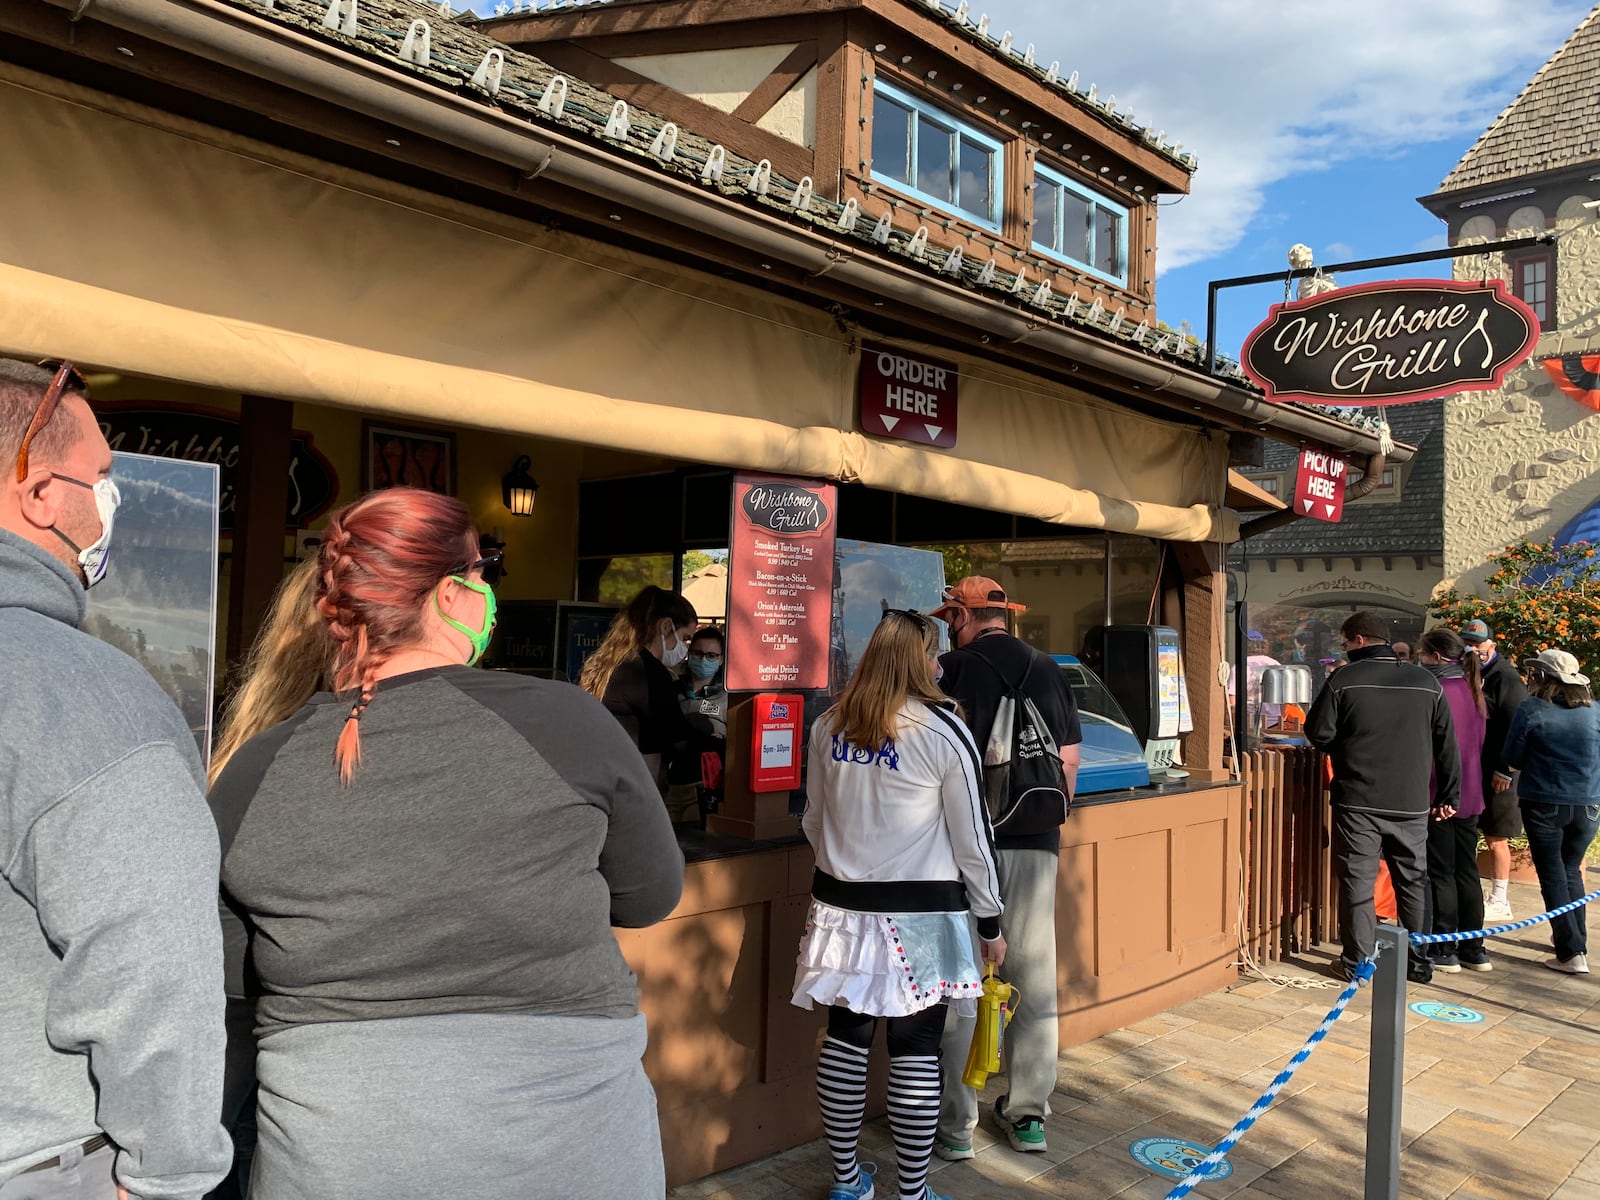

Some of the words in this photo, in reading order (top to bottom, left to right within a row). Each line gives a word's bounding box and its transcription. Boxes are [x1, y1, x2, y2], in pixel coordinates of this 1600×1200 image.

[1274, 303, 1469, 364] Wishbone
[877, 352, 946, 391] ORDER
[1330, 339, 1449, 393] Grill
[886, 384, 937, 418] HERE
[1303, 449, 1329, 475] PICK
[1329, 456, 1344, 477] UP
[750, 487, 812, 511] Wishbone
[1307, 475, 1336, 500] HERE
[769, 508, 806, 531] Grill
[754, 540, 779, 551] Smoked
[779, 542, 801, 553] Turkey
[801, 545, 813, 556] Leg
[756, 570, 807, 583] Bacon-on-a-Stick
[757, 601, 777, 610] Orion's
[779, 602, 805, 612] Asteroids
[761, 634, 781, 643] Chef's
[783, 634, 798, 644] Plate
[758, 664, 779, 674] Bottled
[780, 665, 799, 674] Drinks
[770, 711, 788, 719] Island
[771, 703, 788, 711] Kings
